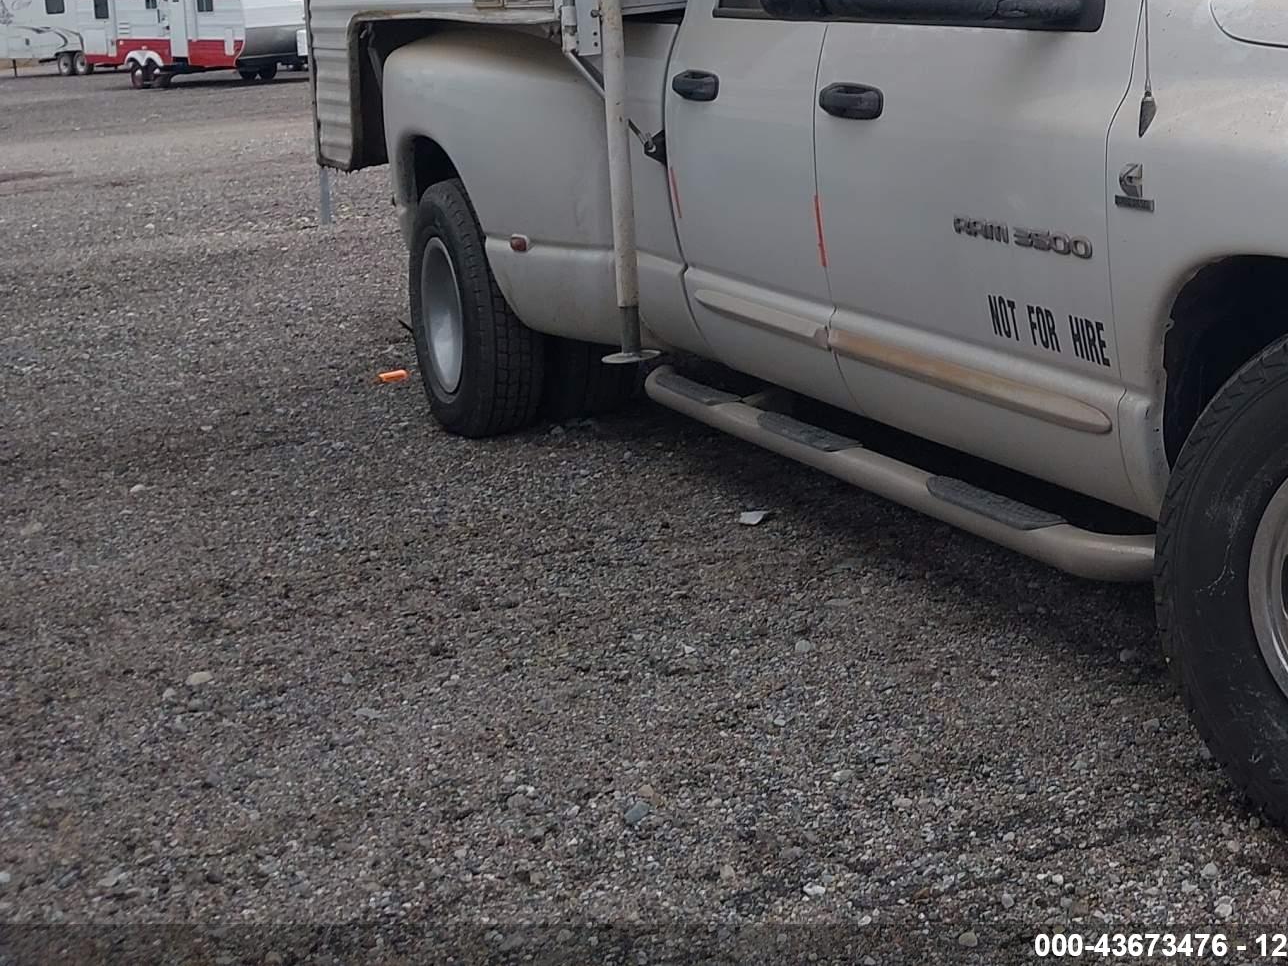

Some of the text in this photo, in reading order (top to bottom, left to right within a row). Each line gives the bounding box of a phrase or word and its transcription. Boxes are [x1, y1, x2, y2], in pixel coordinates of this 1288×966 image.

[953, 218, 1093, 260] RAM 3500
[988, 294, 1111, 367] NOT FOR HIRE
